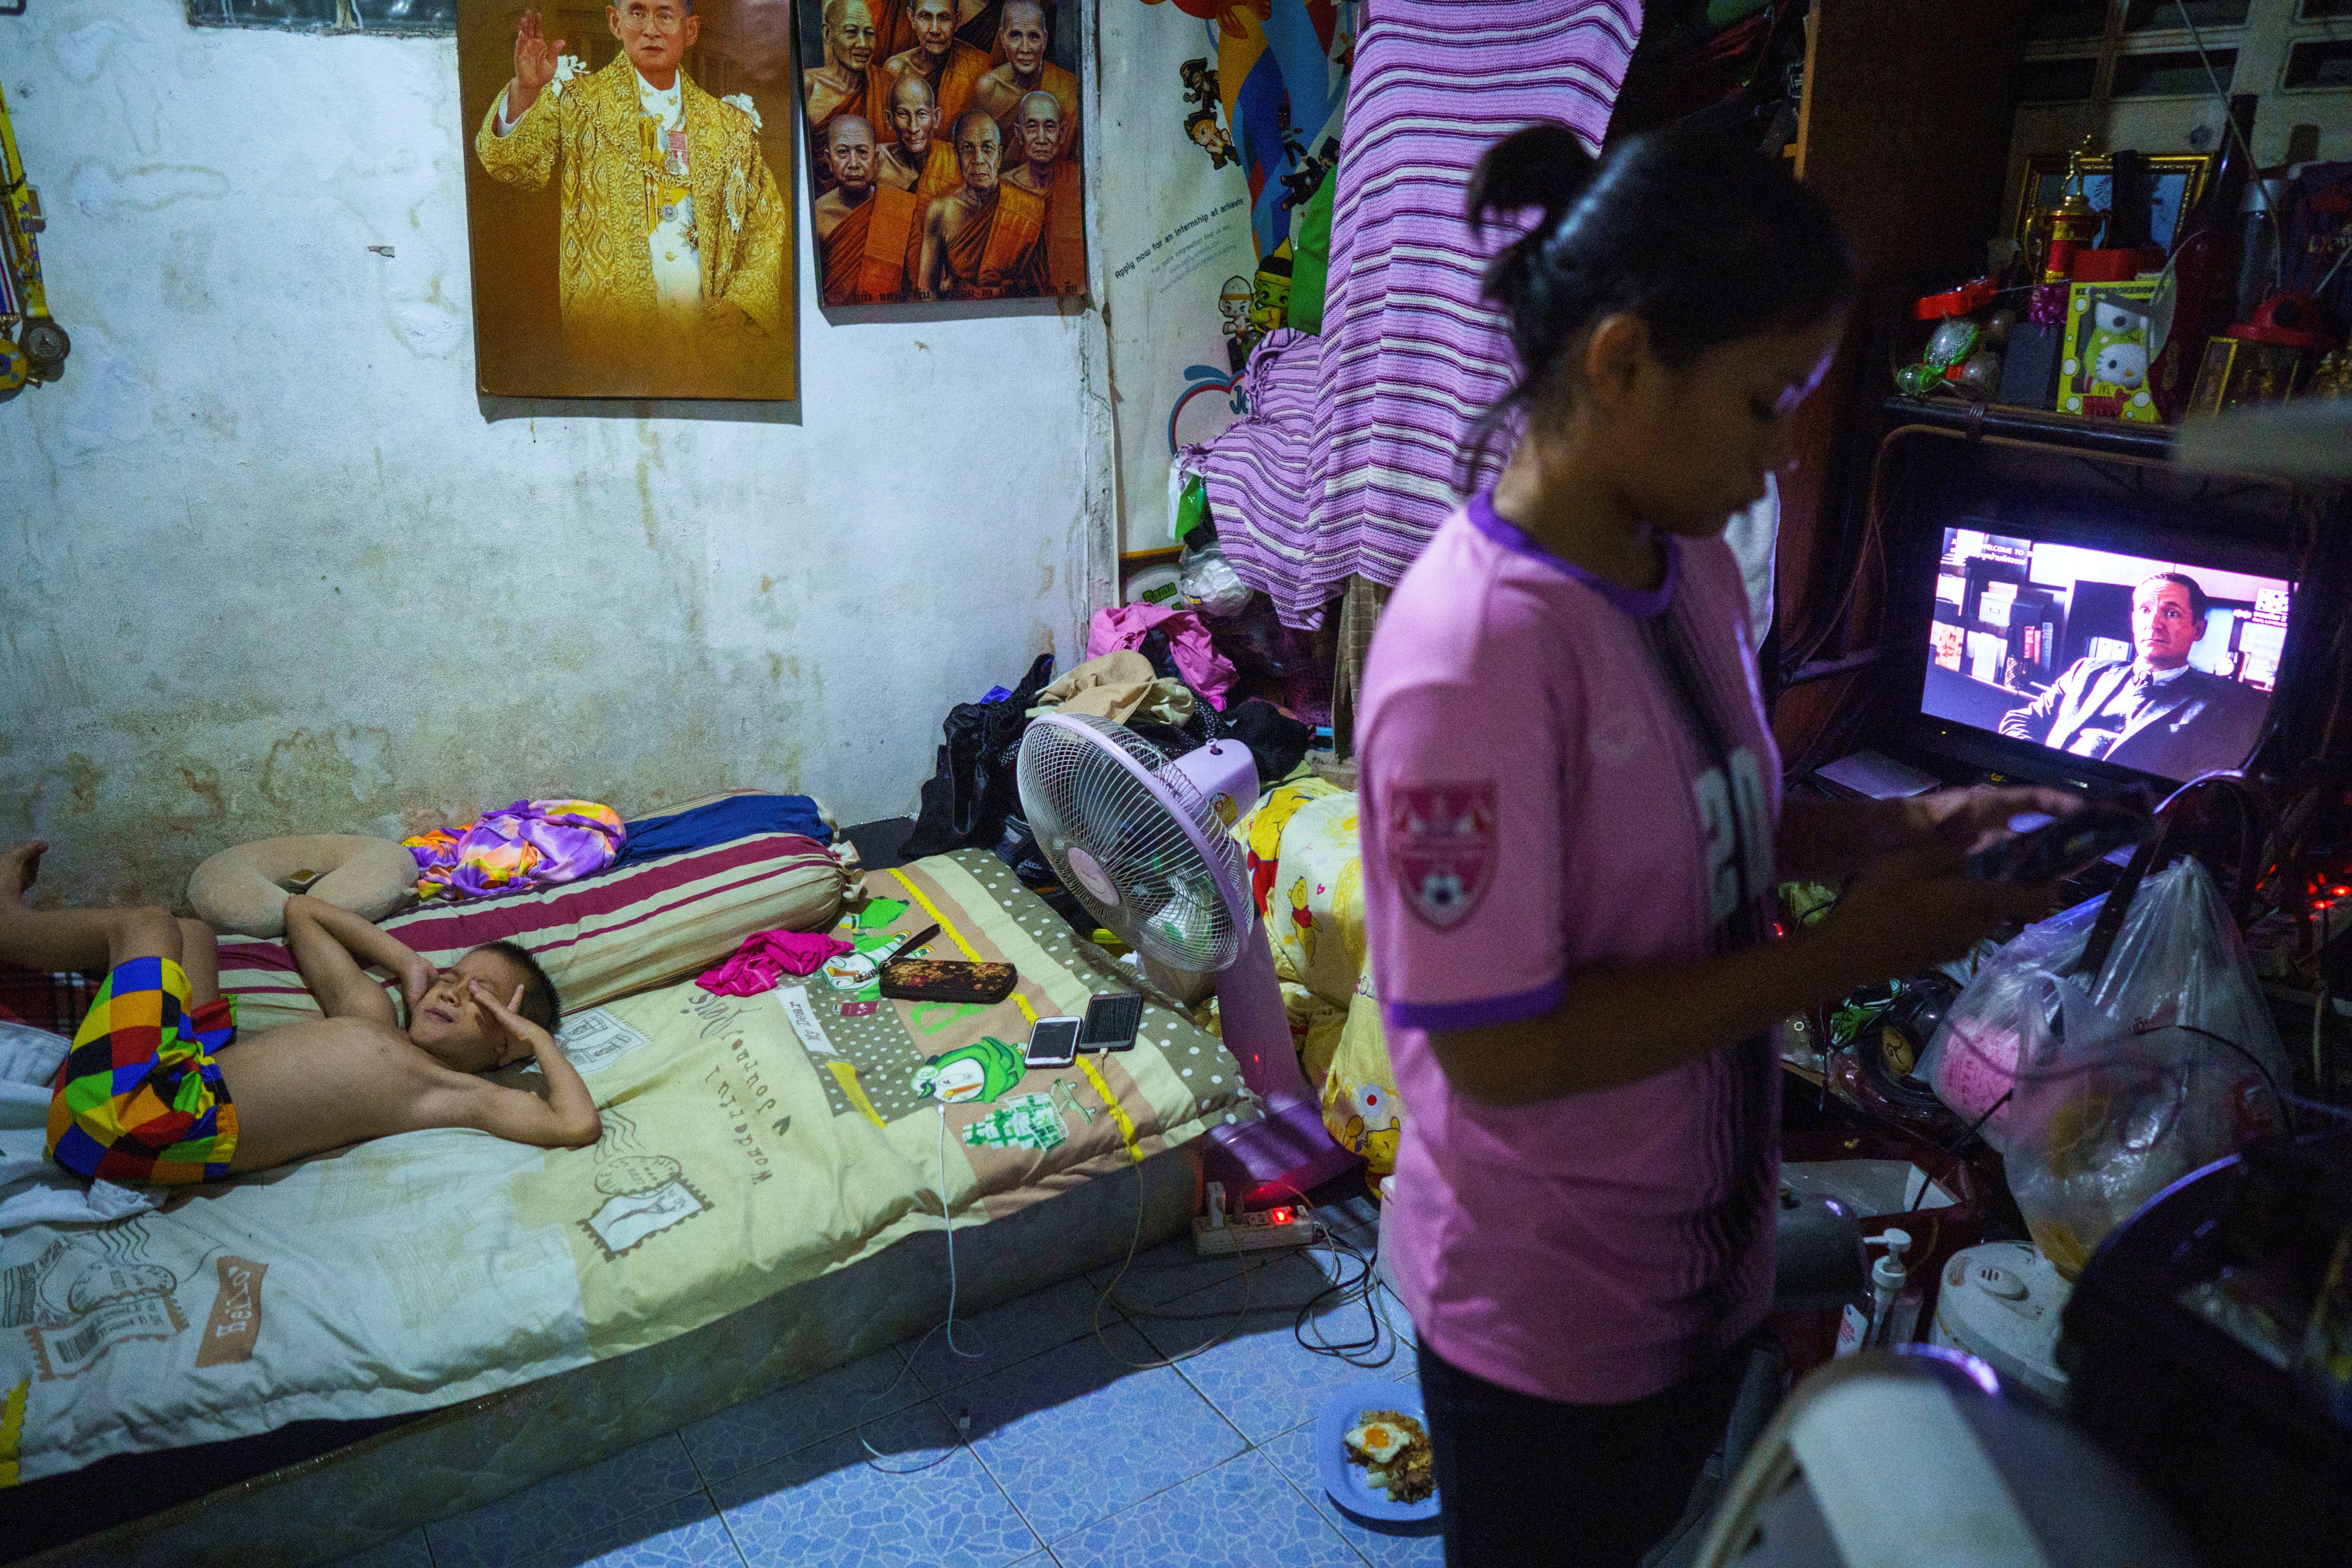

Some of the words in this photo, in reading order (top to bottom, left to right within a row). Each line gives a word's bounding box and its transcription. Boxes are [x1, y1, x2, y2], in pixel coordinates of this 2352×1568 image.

[1115, 260, 1135, 279] Apply
[1136, 248, 1151, 263] now
[1152, 240, 1163, 251] for
[1165, 234, 1174, 243] an
[1175, 214, 1209, 236] internship
[1211, 208, 1219, 218] at
[1221, 198, 1244, 212] arkavis
[1982, 544, 2013, 554] WELCOME
[789, 1002, 811, 1026] Dear
[704, 1065, 772, 1186] Wonderful
